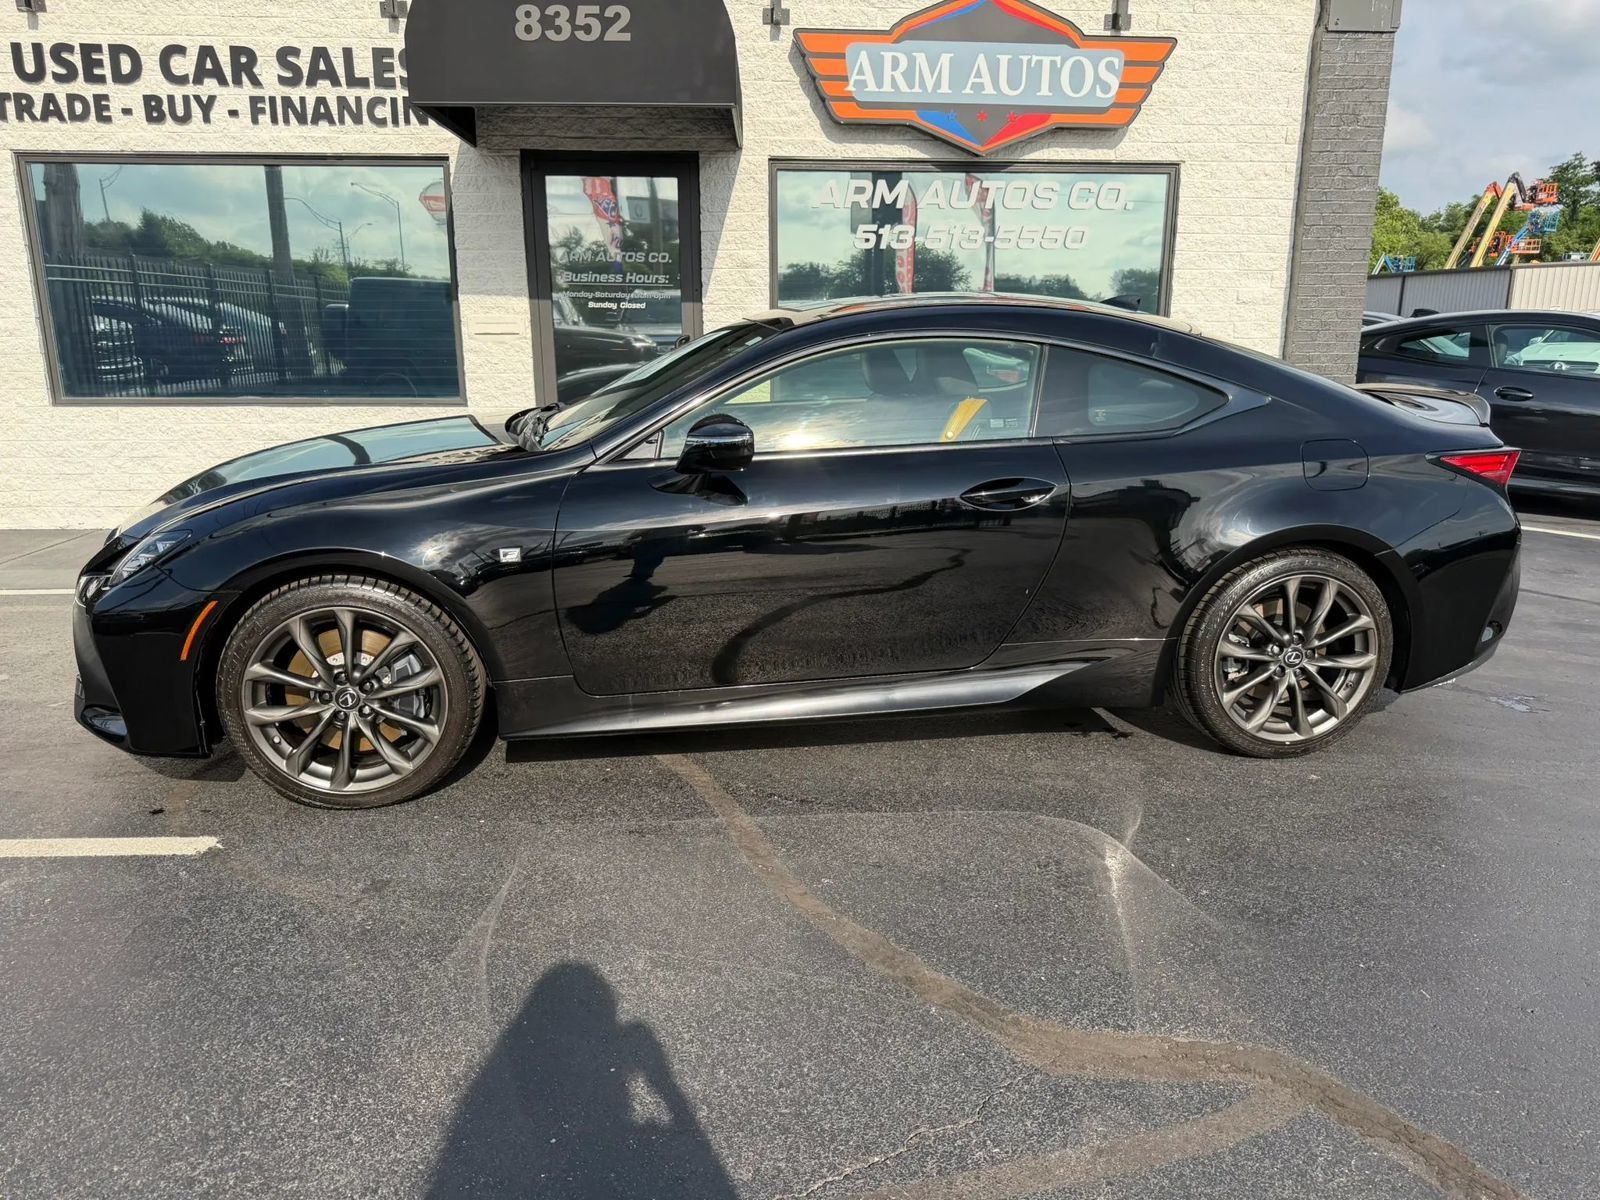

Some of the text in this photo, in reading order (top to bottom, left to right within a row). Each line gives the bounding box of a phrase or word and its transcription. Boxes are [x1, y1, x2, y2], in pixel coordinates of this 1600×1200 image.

[514, 4, 631, 41] 8352
[10, 42, 143, 84] USED
[159, 44, 263, 87] CAR
[845, 50, 1121, 99] ARM AUTOS
[143, 94, 217, 125] BUY
[811, 178, 1135, 211] ARM AUTOS CO.
[853, 223, 1090, 250] 513-513-5550
[559, 250, 673, 263] ARM AUTOS CO.
[562, 271, 670, 284] Business Hours:
[588, 301, 618, 309] Sunday
